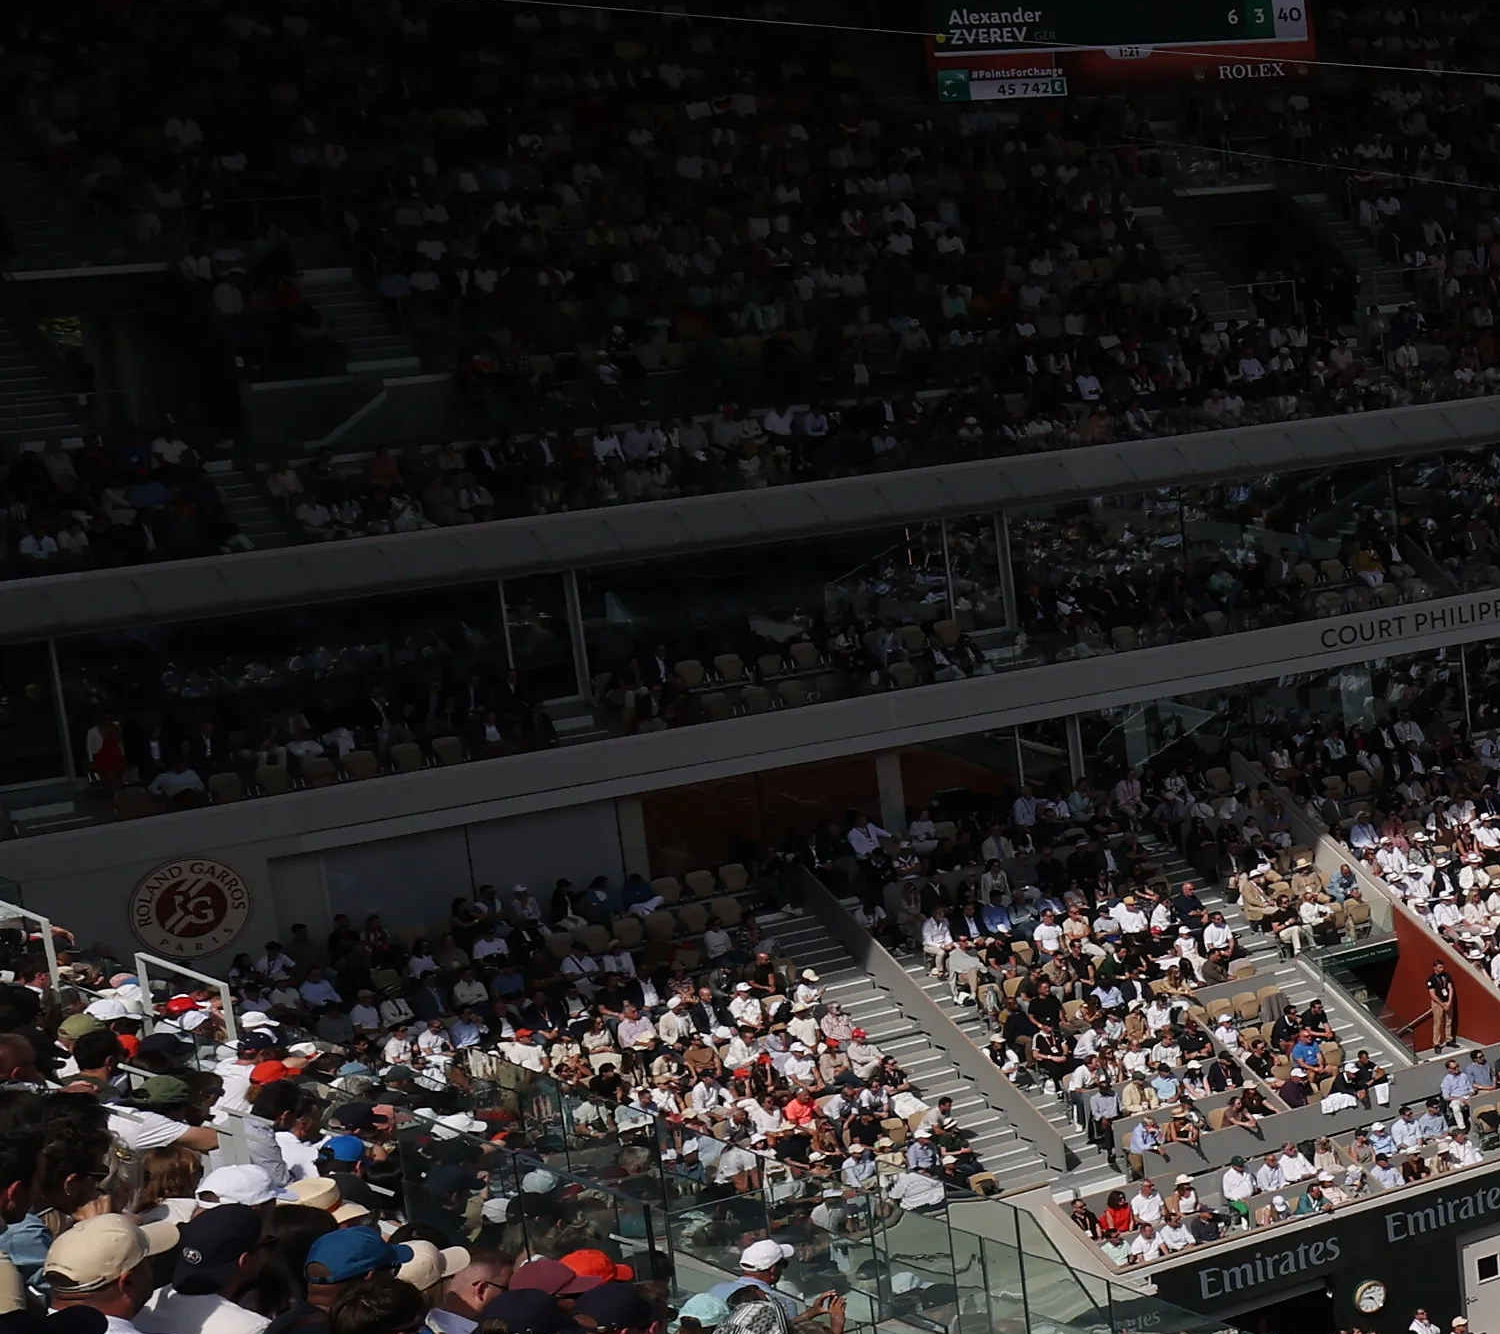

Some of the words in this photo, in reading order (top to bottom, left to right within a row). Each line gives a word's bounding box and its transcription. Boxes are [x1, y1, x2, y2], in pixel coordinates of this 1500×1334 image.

[948, 7, 1042, 26] Alexander
[1227, 9, 1240, 25] 6
[1254, 8, 1265, 24] 3
[1278, 7, 1302, 22] 40
[950, 27, 1028, 45] ZVEREV
[1034, 31, 1057, 41] GER
[1119, 46, 1140, 57] 1:21
[971, 67, 1063, 80] #PointsForChange
[1218, 63, 1286, 80] ROLEX
[997, 83, 1016, 95] 45
[1021, 80, 1050, 94] 742
[1320, 615, 1408, 649] COURT
[137, 866, 182, 928] ROLAND
[190, 862, 247, 911] GARROS
[160, 927, 233, 952] PARIS
[1199, 1234, 1341, 1301] Emirates
